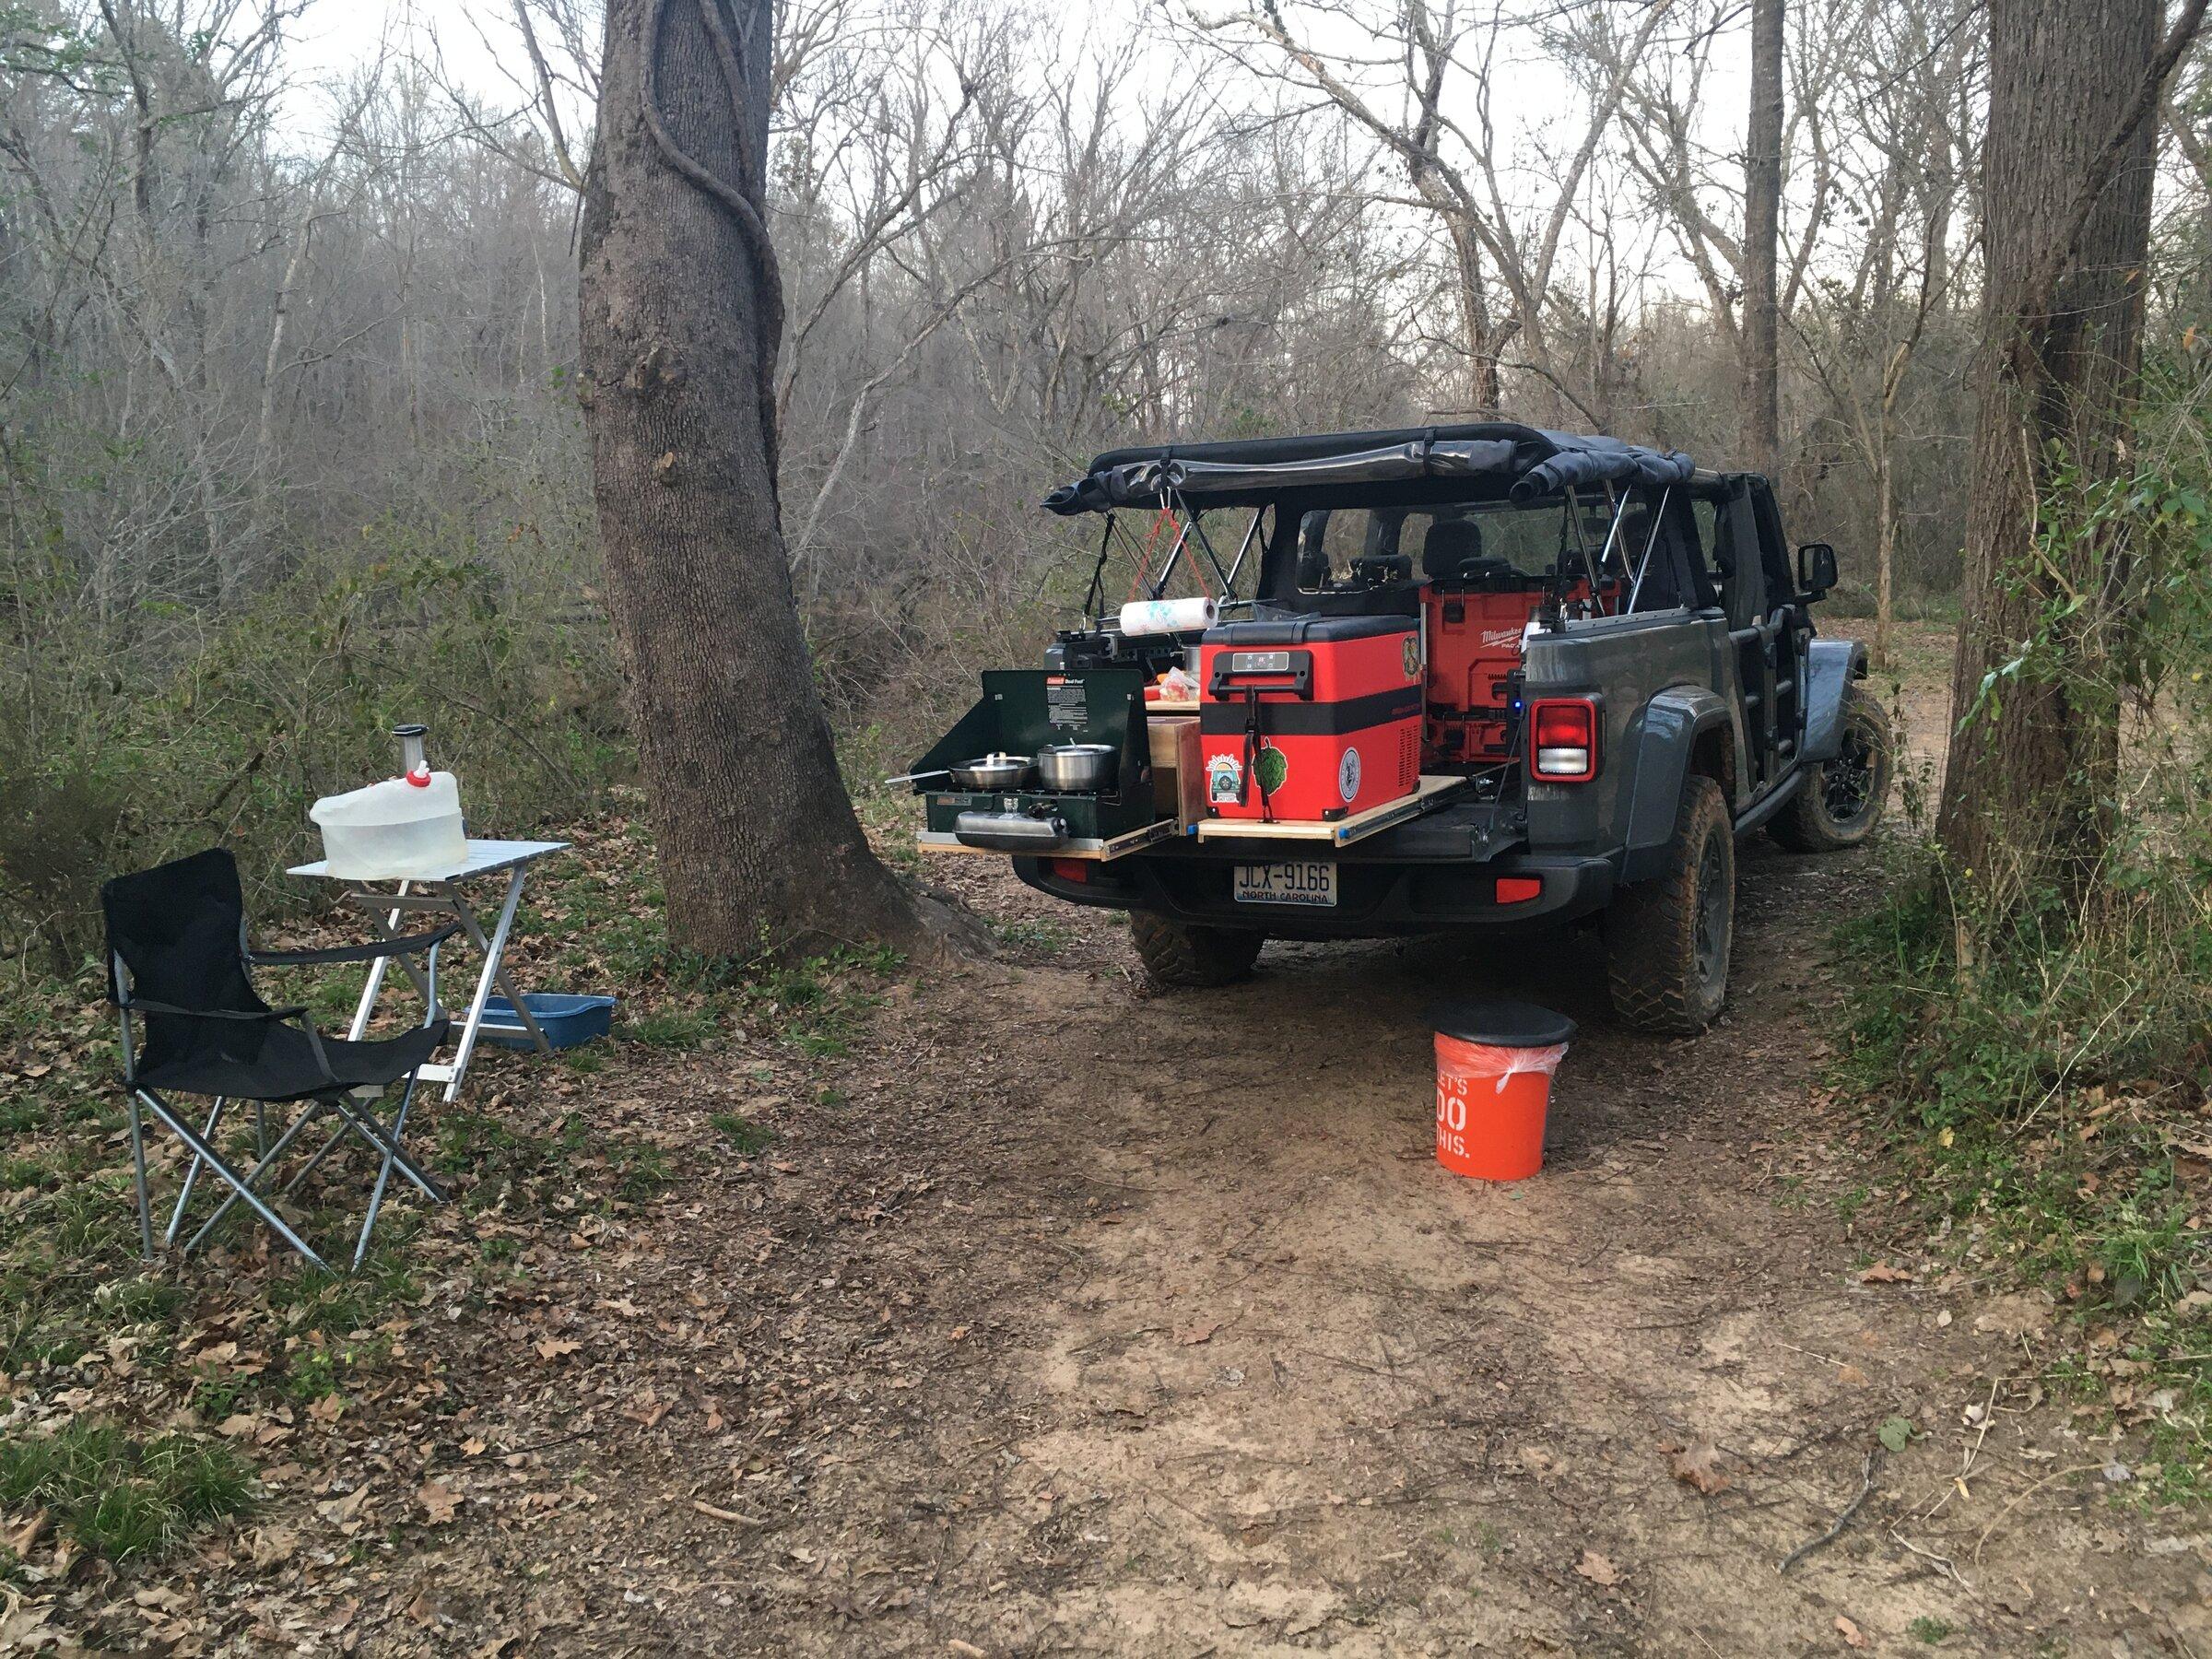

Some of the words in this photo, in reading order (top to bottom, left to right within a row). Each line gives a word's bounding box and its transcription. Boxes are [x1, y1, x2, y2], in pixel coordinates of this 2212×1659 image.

[1480, 627, 1523, 643] Milwaukee
[1239, 864, 1330, 890] JCX-9166
[1242, 890, 1277, 900] NORTH
[1279, 892, 1328, 903] CAROLINA
